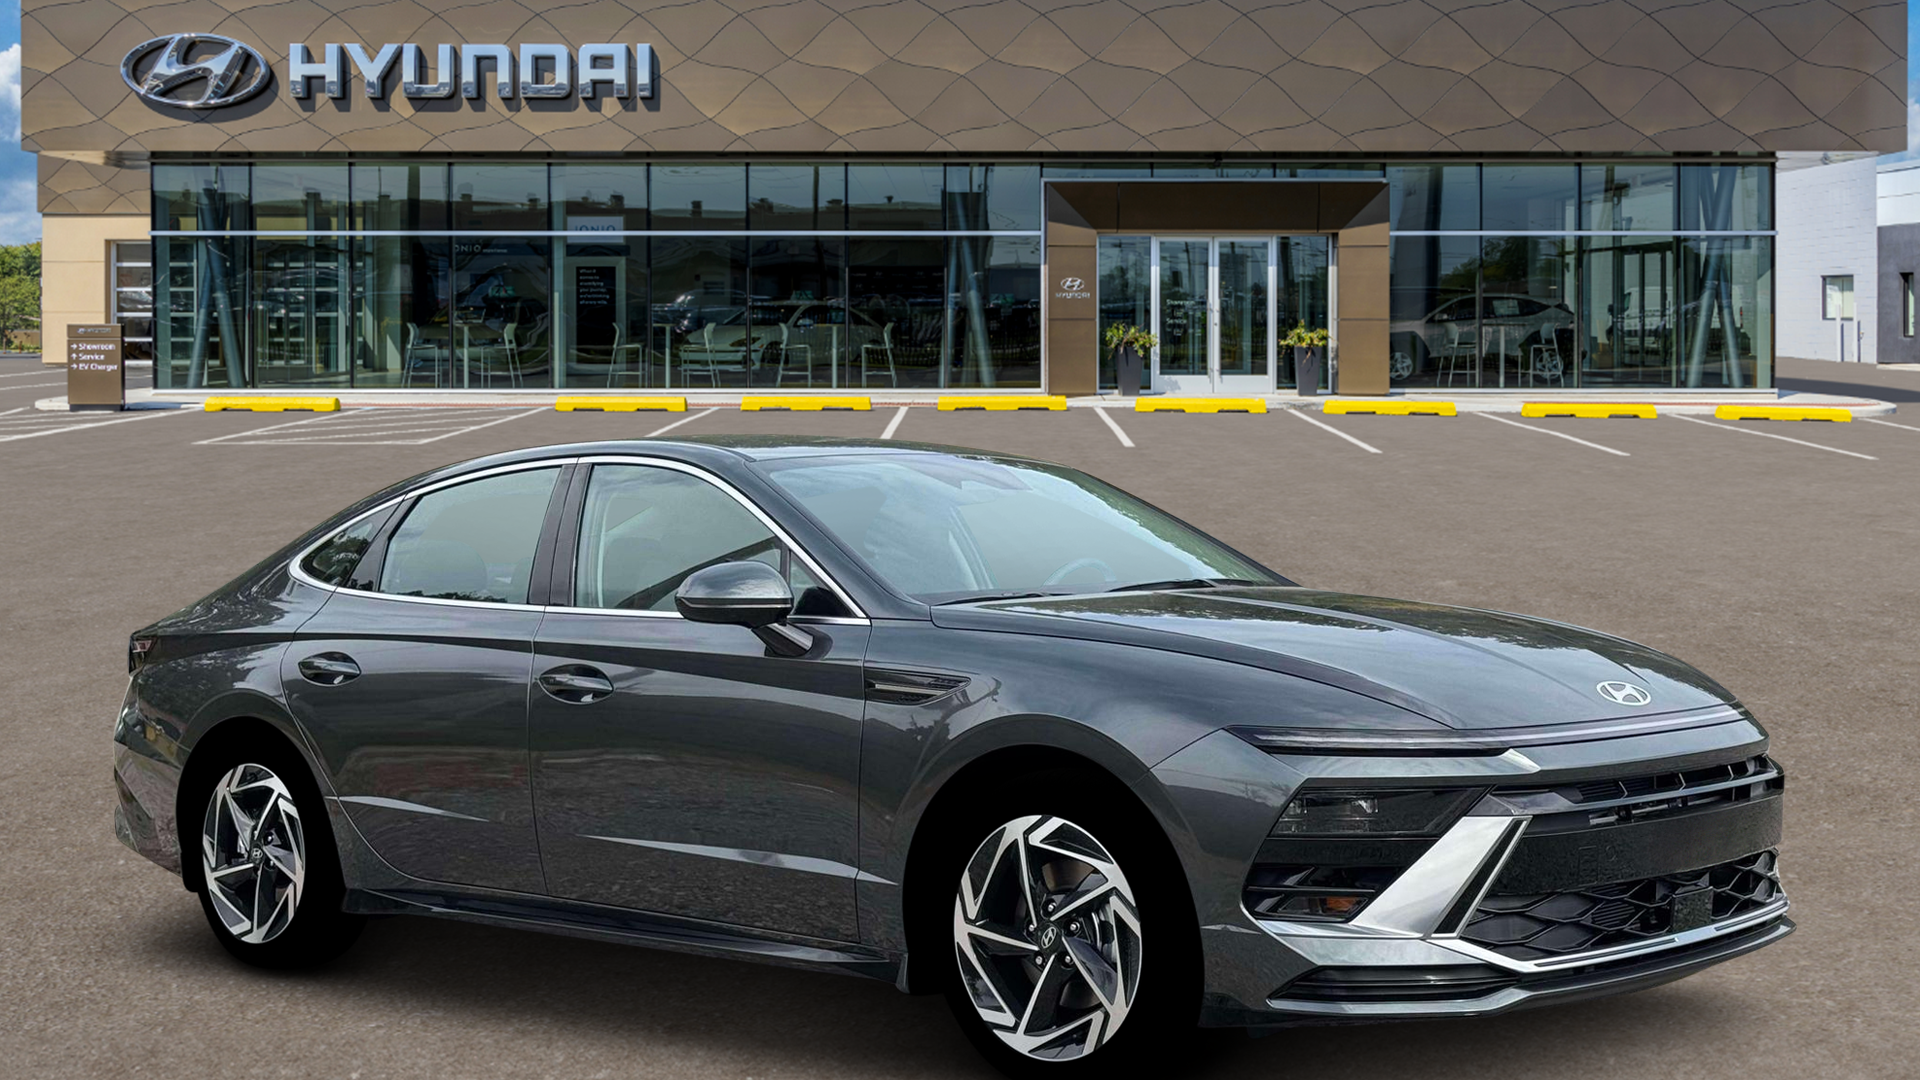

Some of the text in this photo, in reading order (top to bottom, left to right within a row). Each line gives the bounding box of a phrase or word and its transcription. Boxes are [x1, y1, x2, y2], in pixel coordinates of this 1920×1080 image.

[289, 42, 653, 100] HYUNDAI
[78, 342, 116, 350] Showroom
[78, 352, 105, 361] Service
[90, 363, 118, 372] Charger
